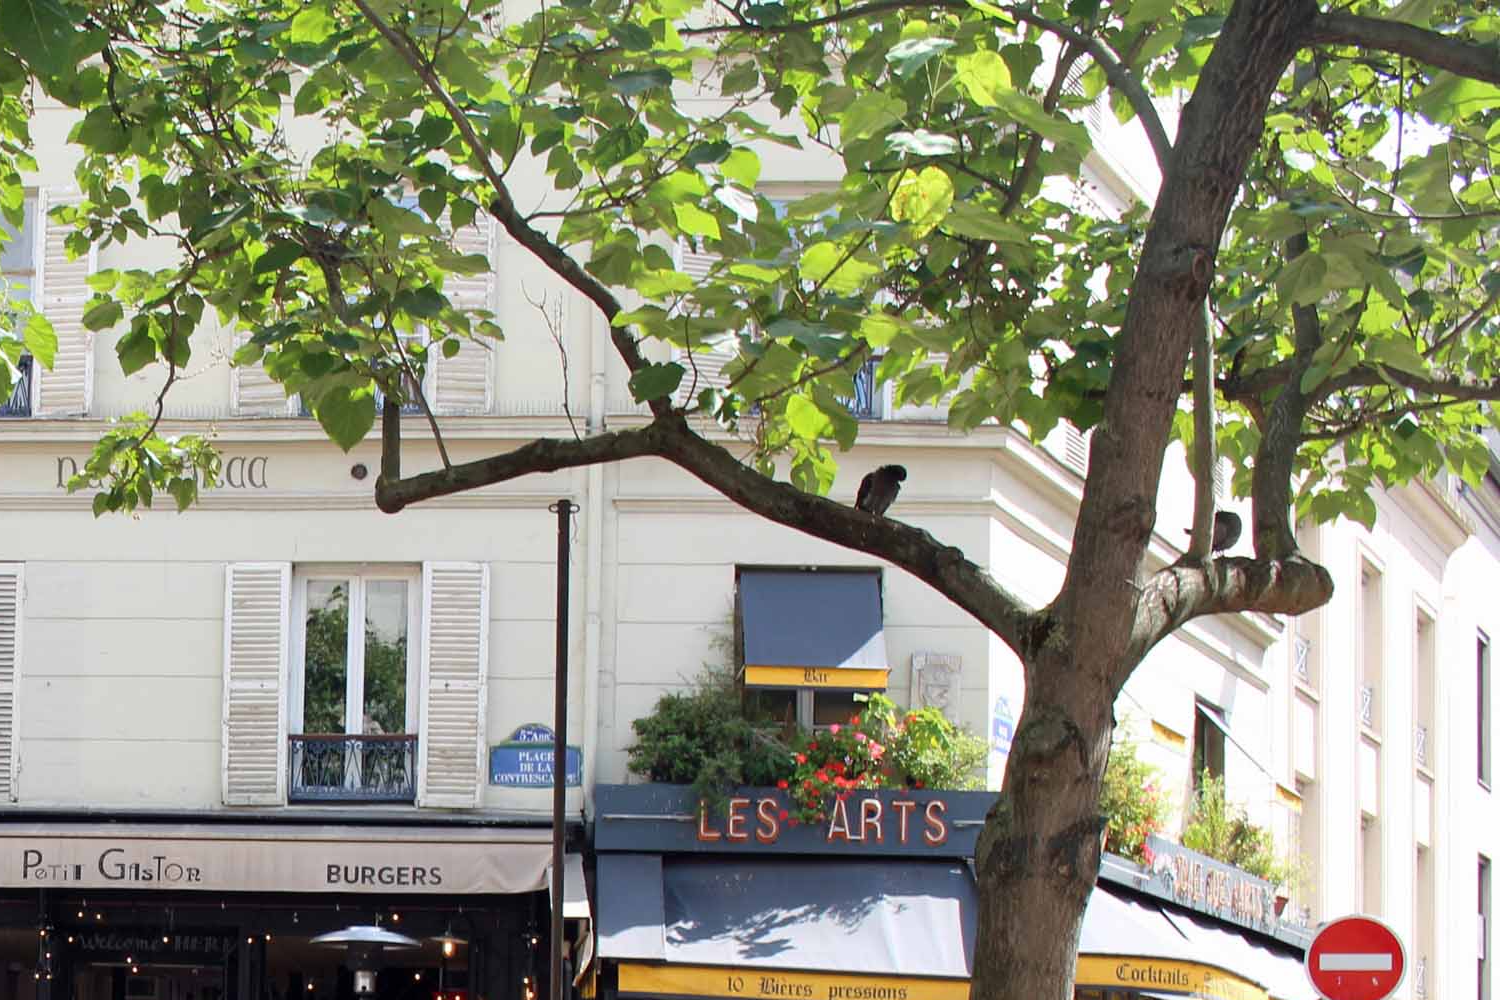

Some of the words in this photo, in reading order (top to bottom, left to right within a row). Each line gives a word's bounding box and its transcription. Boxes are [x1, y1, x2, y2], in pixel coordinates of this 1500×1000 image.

[494, 774, 580, 784] CONTRESCAPE
[520, 763, 534, 773] DE
[537, 763, 553, 773] LA
[698, 796, 779, 844] LES
[827, 796, 949, 846] ARTS
[326, 863, 442, 886] BURGERS
[1116, 963, 1189, 986] Cocktails
[726, 976, 744, 992] 10
[759, 975, 813, 997] Bières
[828, 983, 908, 1000] pressions
